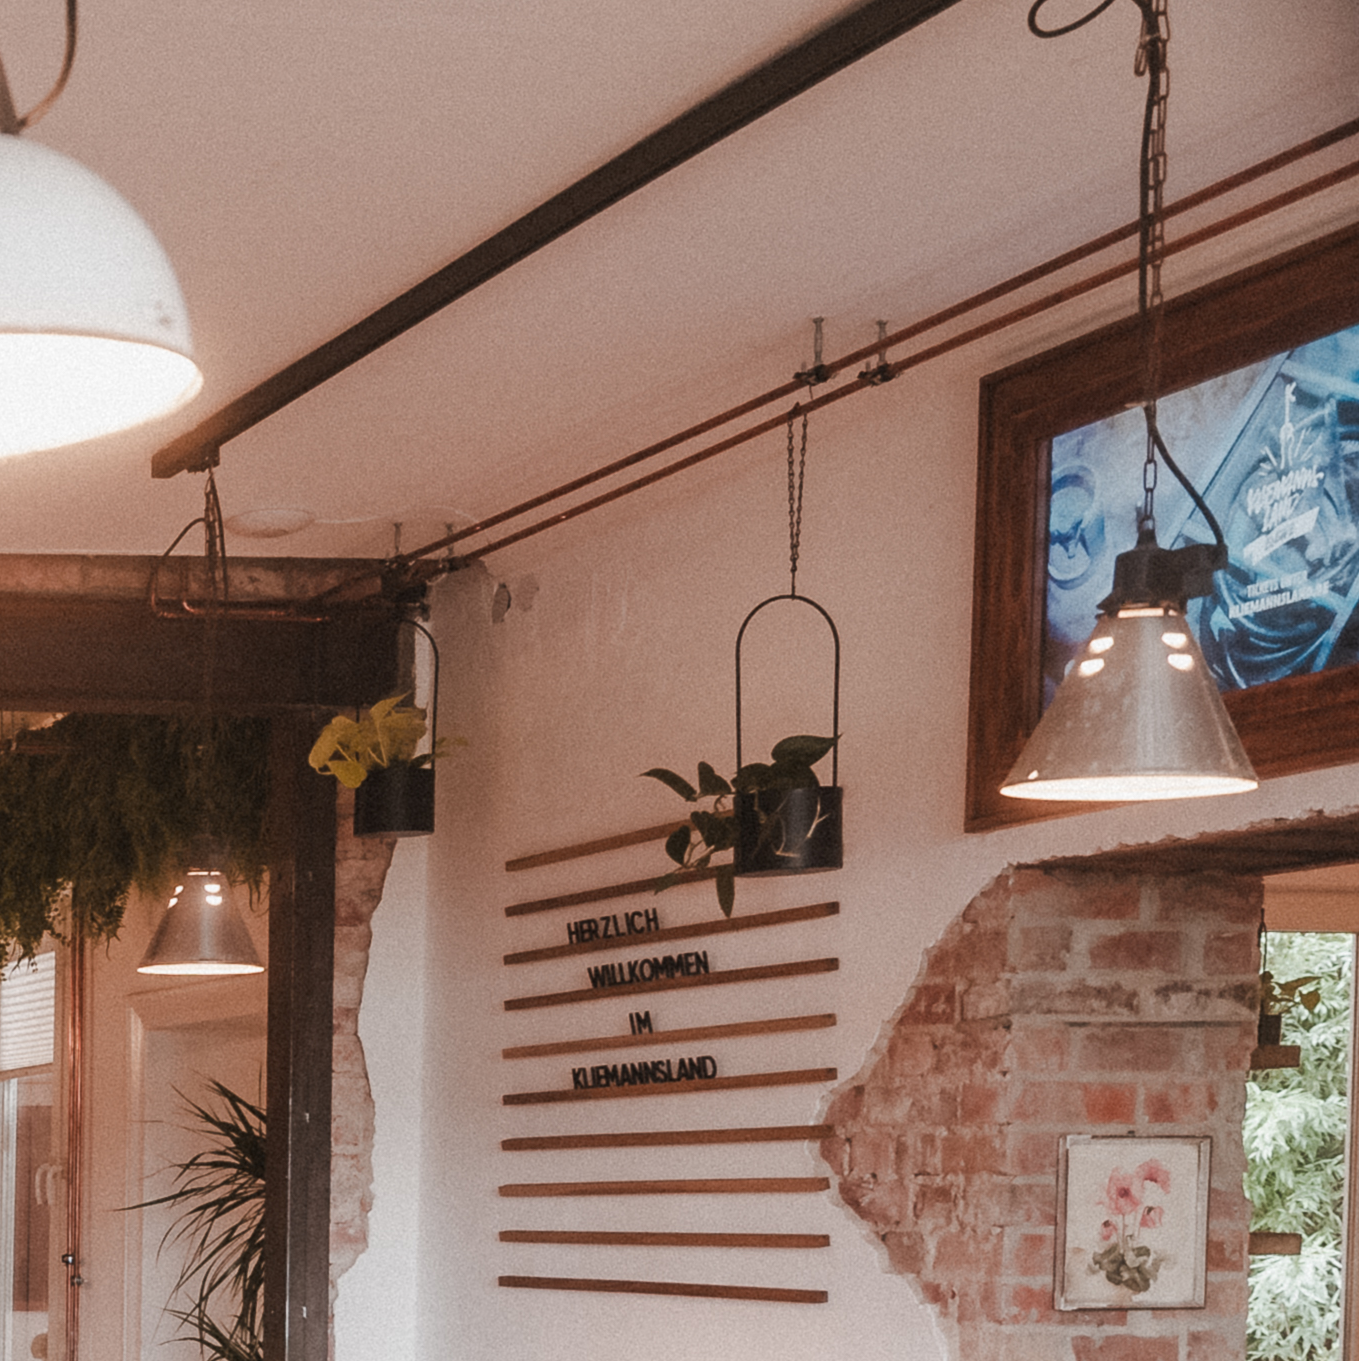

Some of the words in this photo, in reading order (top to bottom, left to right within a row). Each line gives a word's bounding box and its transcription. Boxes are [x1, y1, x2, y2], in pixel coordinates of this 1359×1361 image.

[567, 908, 660, 945] HERZLICH
[587, 950, 710, 990] WILLKOMMEN
[628, 1010, 654, 1036] IM
[571, 1055, 718, 1091] KLIEMANNSLAND
